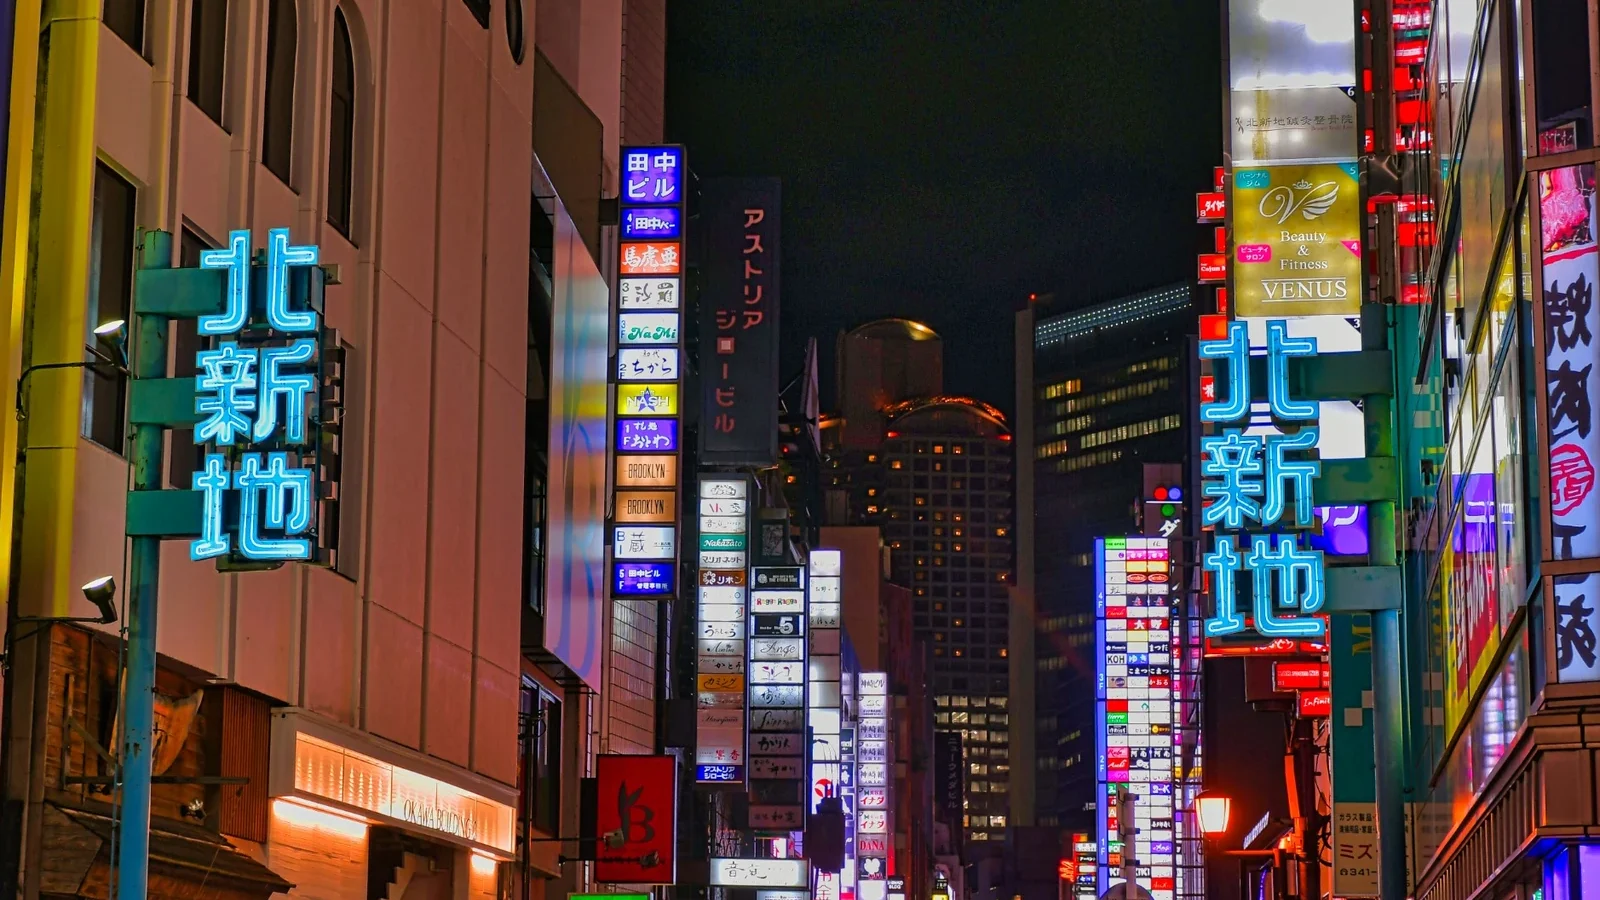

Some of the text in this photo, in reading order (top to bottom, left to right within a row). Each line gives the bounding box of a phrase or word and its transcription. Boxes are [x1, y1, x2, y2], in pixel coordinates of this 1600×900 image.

[1347, 87, 1355, 97] 6
[628, 152, 676, 172] 田中
[1350, 166, 1356, 174] 5
[628, 178, 675, 198] ビル
[1280, 231, 1327, 244] Beauty
[1298, 245, 1310, 256] &
[743, 209, 764, 330] アストリア
[1280, 259, 1329, 270] Fitness
[622, 283, 629, 305] 3F
[1262, 280, 1347, 299] VENUS
[1353, 319, 1361, 328] 3
[628, 327, 677, 341] NaMi
[632, 358, 672, 376] ちから
[714, 311, 737, 433] ジロービル
[190, 227, 320, 562] 北新地
[626, 396, 669, 407] NASH
[631, 434, 670, 449] おとわ
[628, 463, 666, 479] BROOKLYN
[1198, 319, 1325, 637] 北新地
[627, 499, 665, 515] BROOKLYN
[629, 531, 647, 553] 蔵
[702, 556, 743, 564] マリオネット
[628, 569, 661, 578] 田中ビル
[780, 616, 794, 634] 5
[1107, 655, 1125, 664] KOH
[403, 799, 435, 829] OKAWA
[436, 809, 471, 839] BUILDING
[1340, 844, 1378, 859] ミズ
[1350, 868, 1378, 876] 341-
